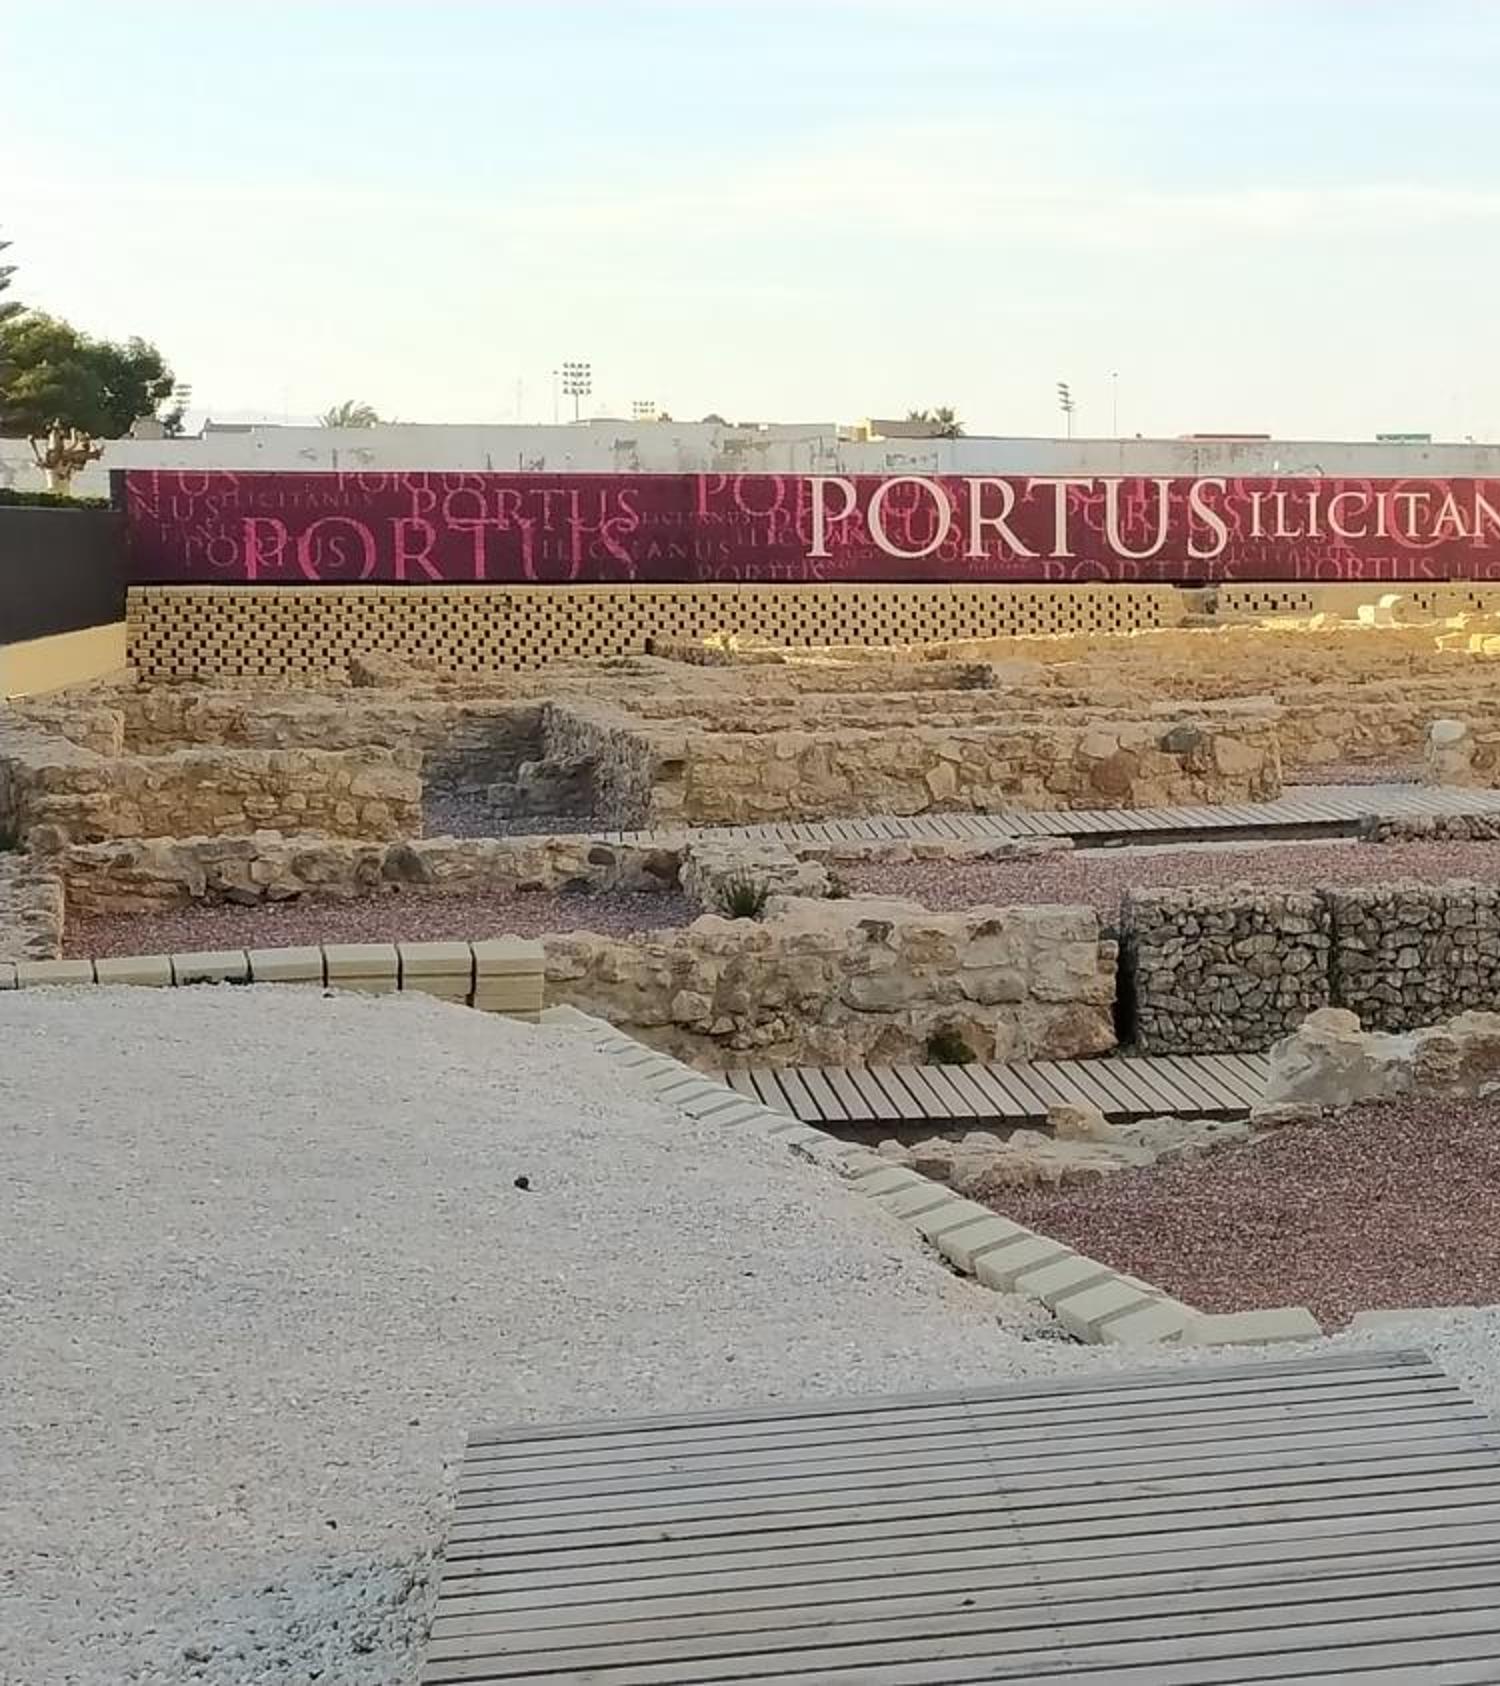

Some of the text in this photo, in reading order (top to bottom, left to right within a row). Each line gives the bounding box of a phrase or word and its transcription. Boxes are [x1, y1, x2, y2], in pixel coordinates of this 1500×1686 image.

[410, 488, 640, 531] PORTUS
[806, 476, 1229, 559] PORTUS
[240, 515, 636, 580] PORTUS
